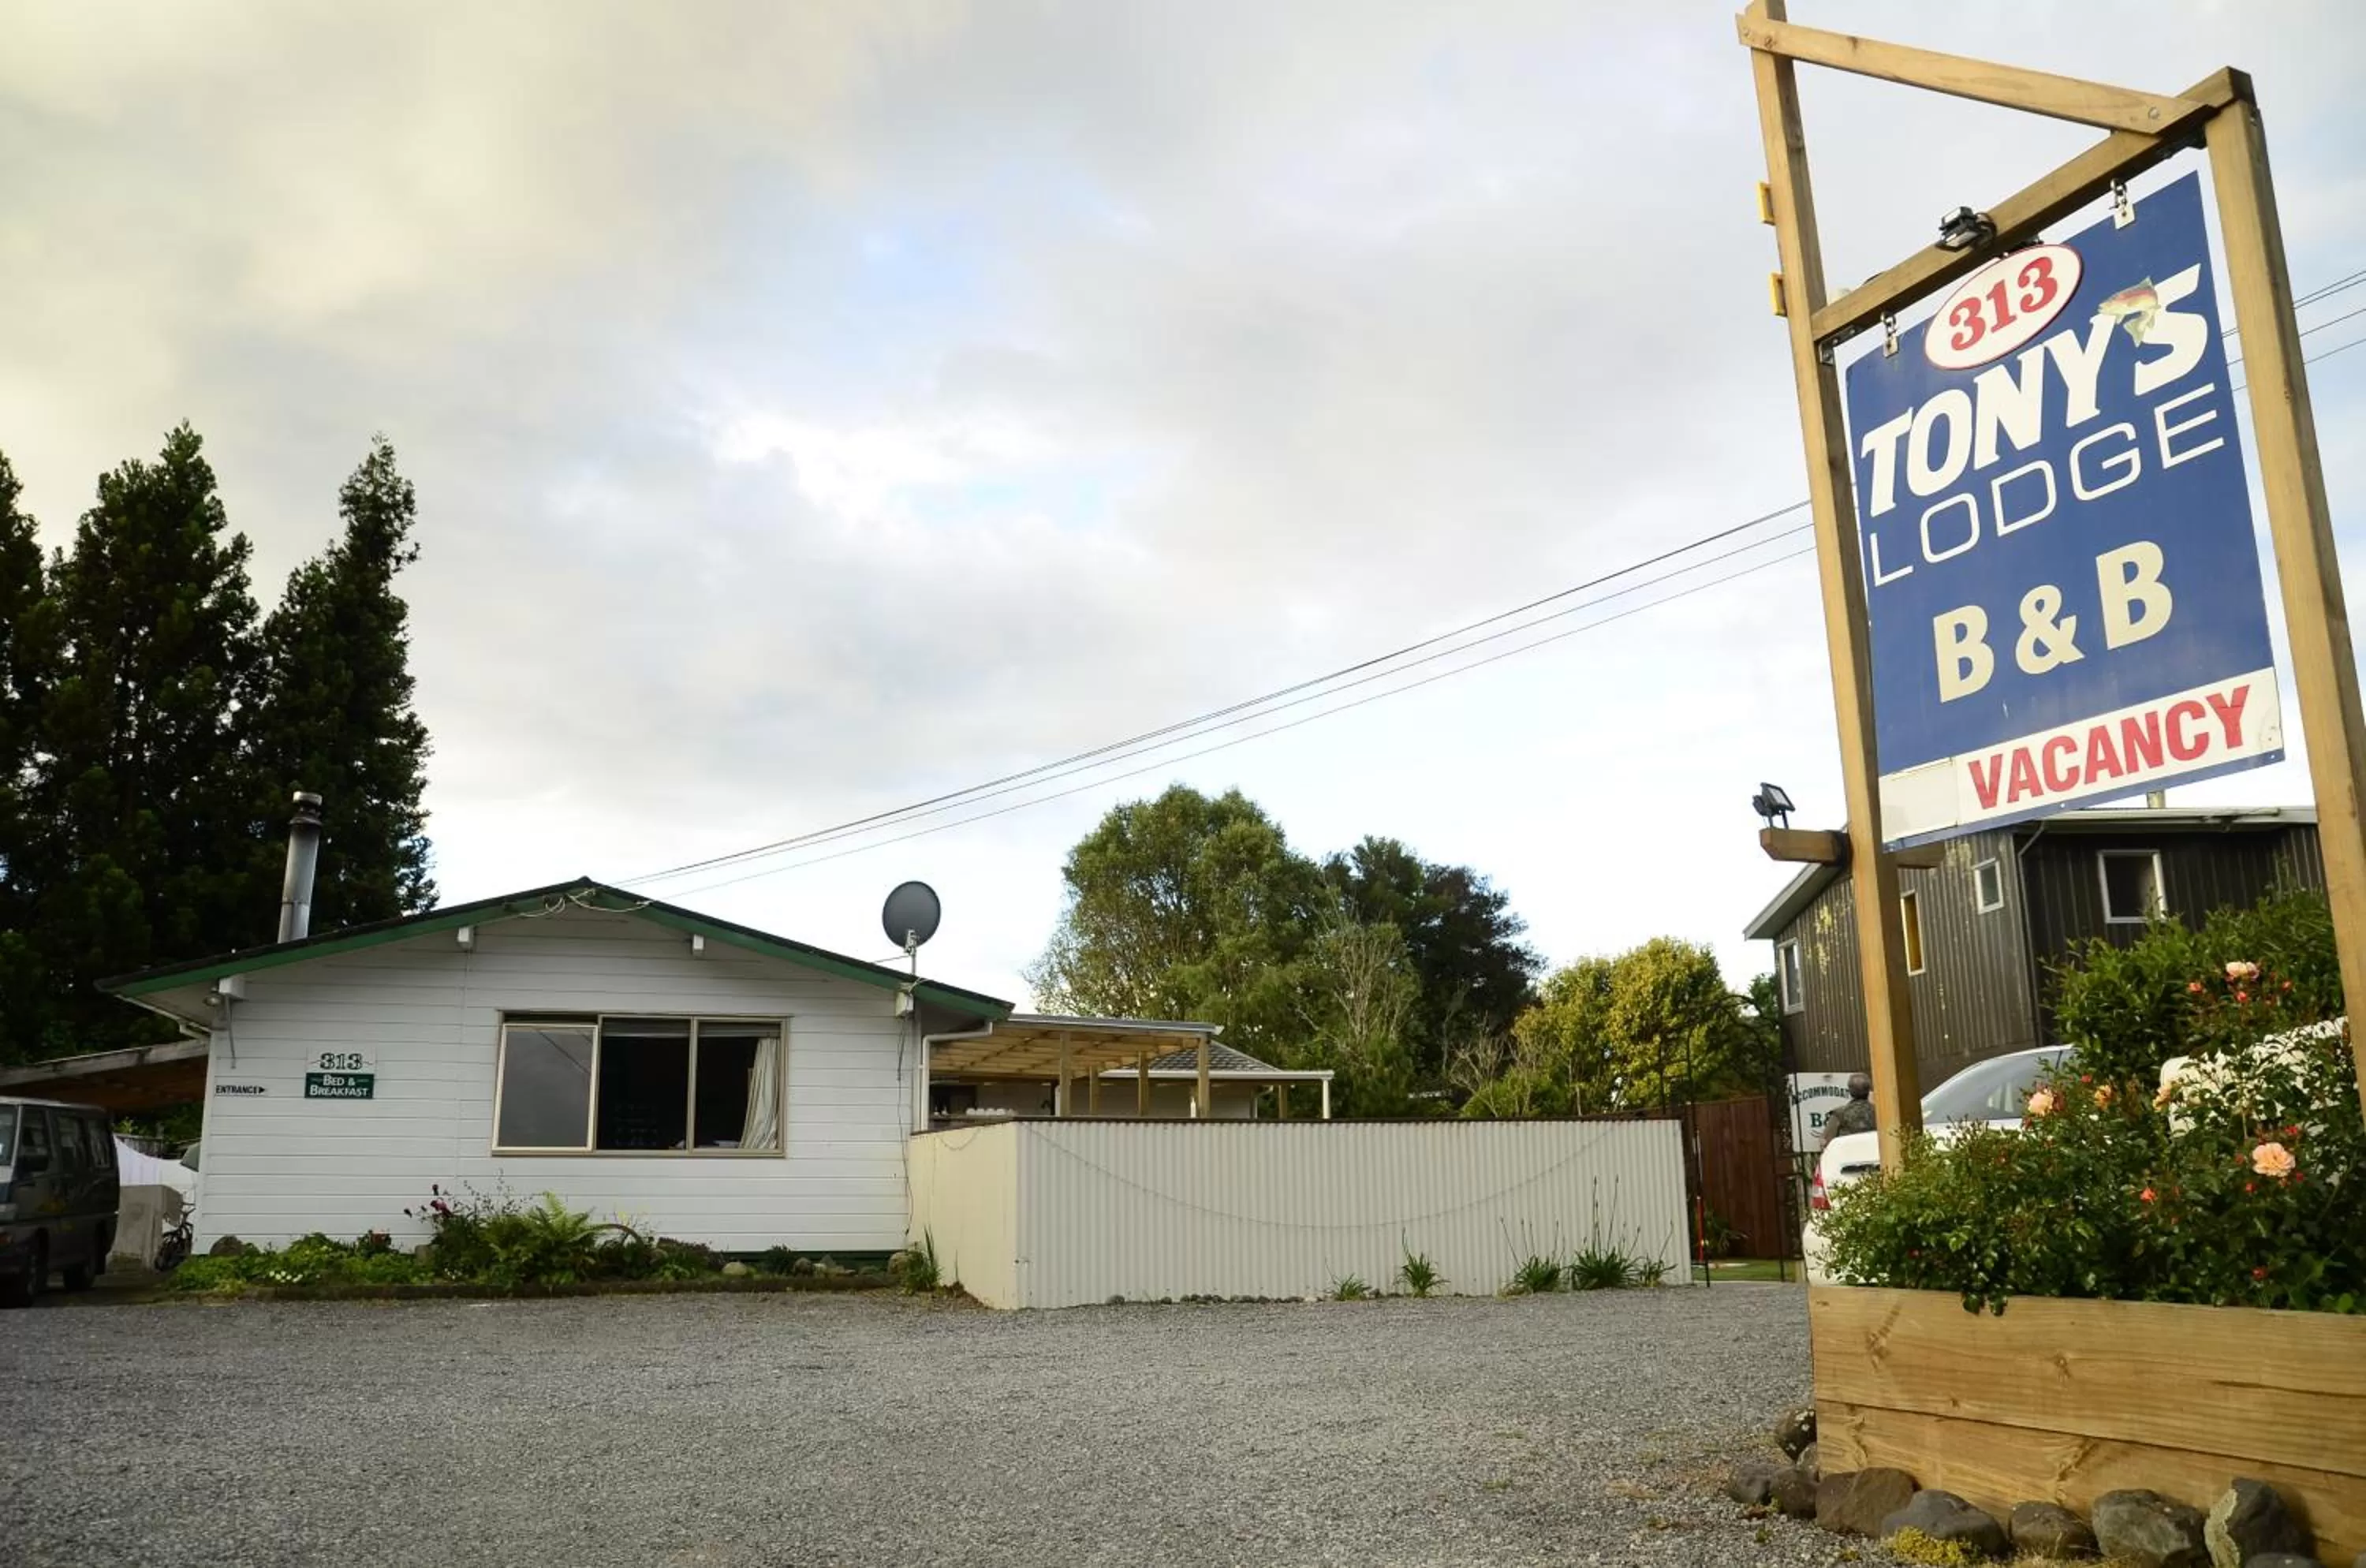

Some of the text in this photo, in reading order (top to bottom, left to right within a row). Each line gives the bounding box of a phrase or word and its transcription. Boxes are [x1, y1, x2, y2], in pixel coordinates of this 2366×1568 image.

[1949, 256, 2058, 351] 313
[1870, 383, 2226, 587] LODGE
[1968, 684, 2250, 811] VACANCY
[319, 1052, 363, 1070] 313
[323, 1073, 345, 1086] BED
[215, 1085, 257, 1094] ENTRANCE
[310, 1084, 368, 1096] BREAKFAST
